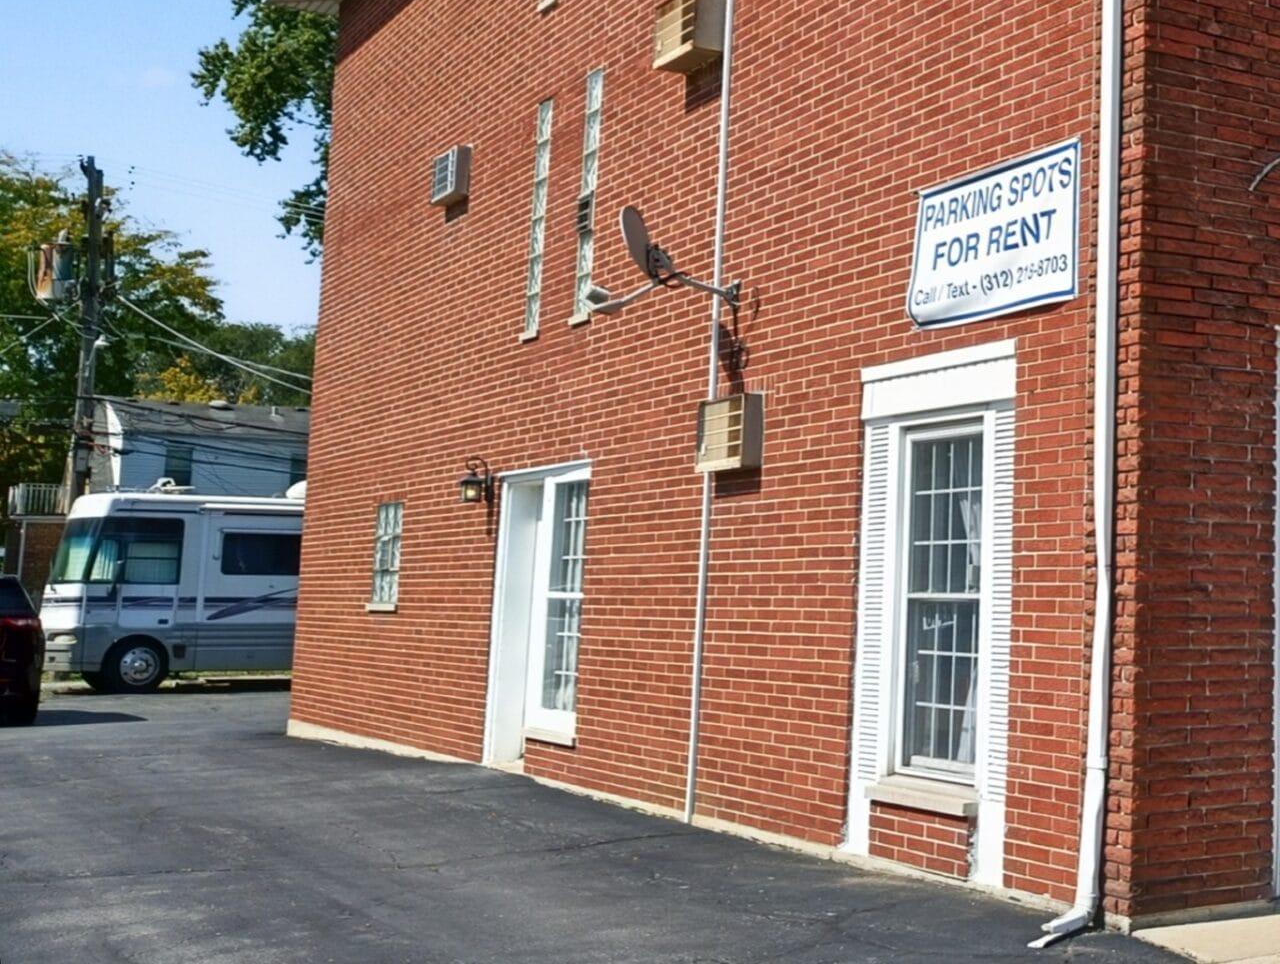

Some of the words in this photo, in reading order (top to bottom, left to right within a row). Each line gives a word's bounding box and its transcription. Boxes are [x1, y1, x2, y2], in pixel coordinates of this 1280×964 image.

[923, 183, 1002, 232] PARKING
[1007, 156, 1072, 206] SPOTS
[932, 231, 980, 271] FOR
[986, 208, 1057, 256] RENT
[914, 288, 937, 306] Call
[946, 280, 970, 300] Text
[980, 267, 1014, 296] (312)
